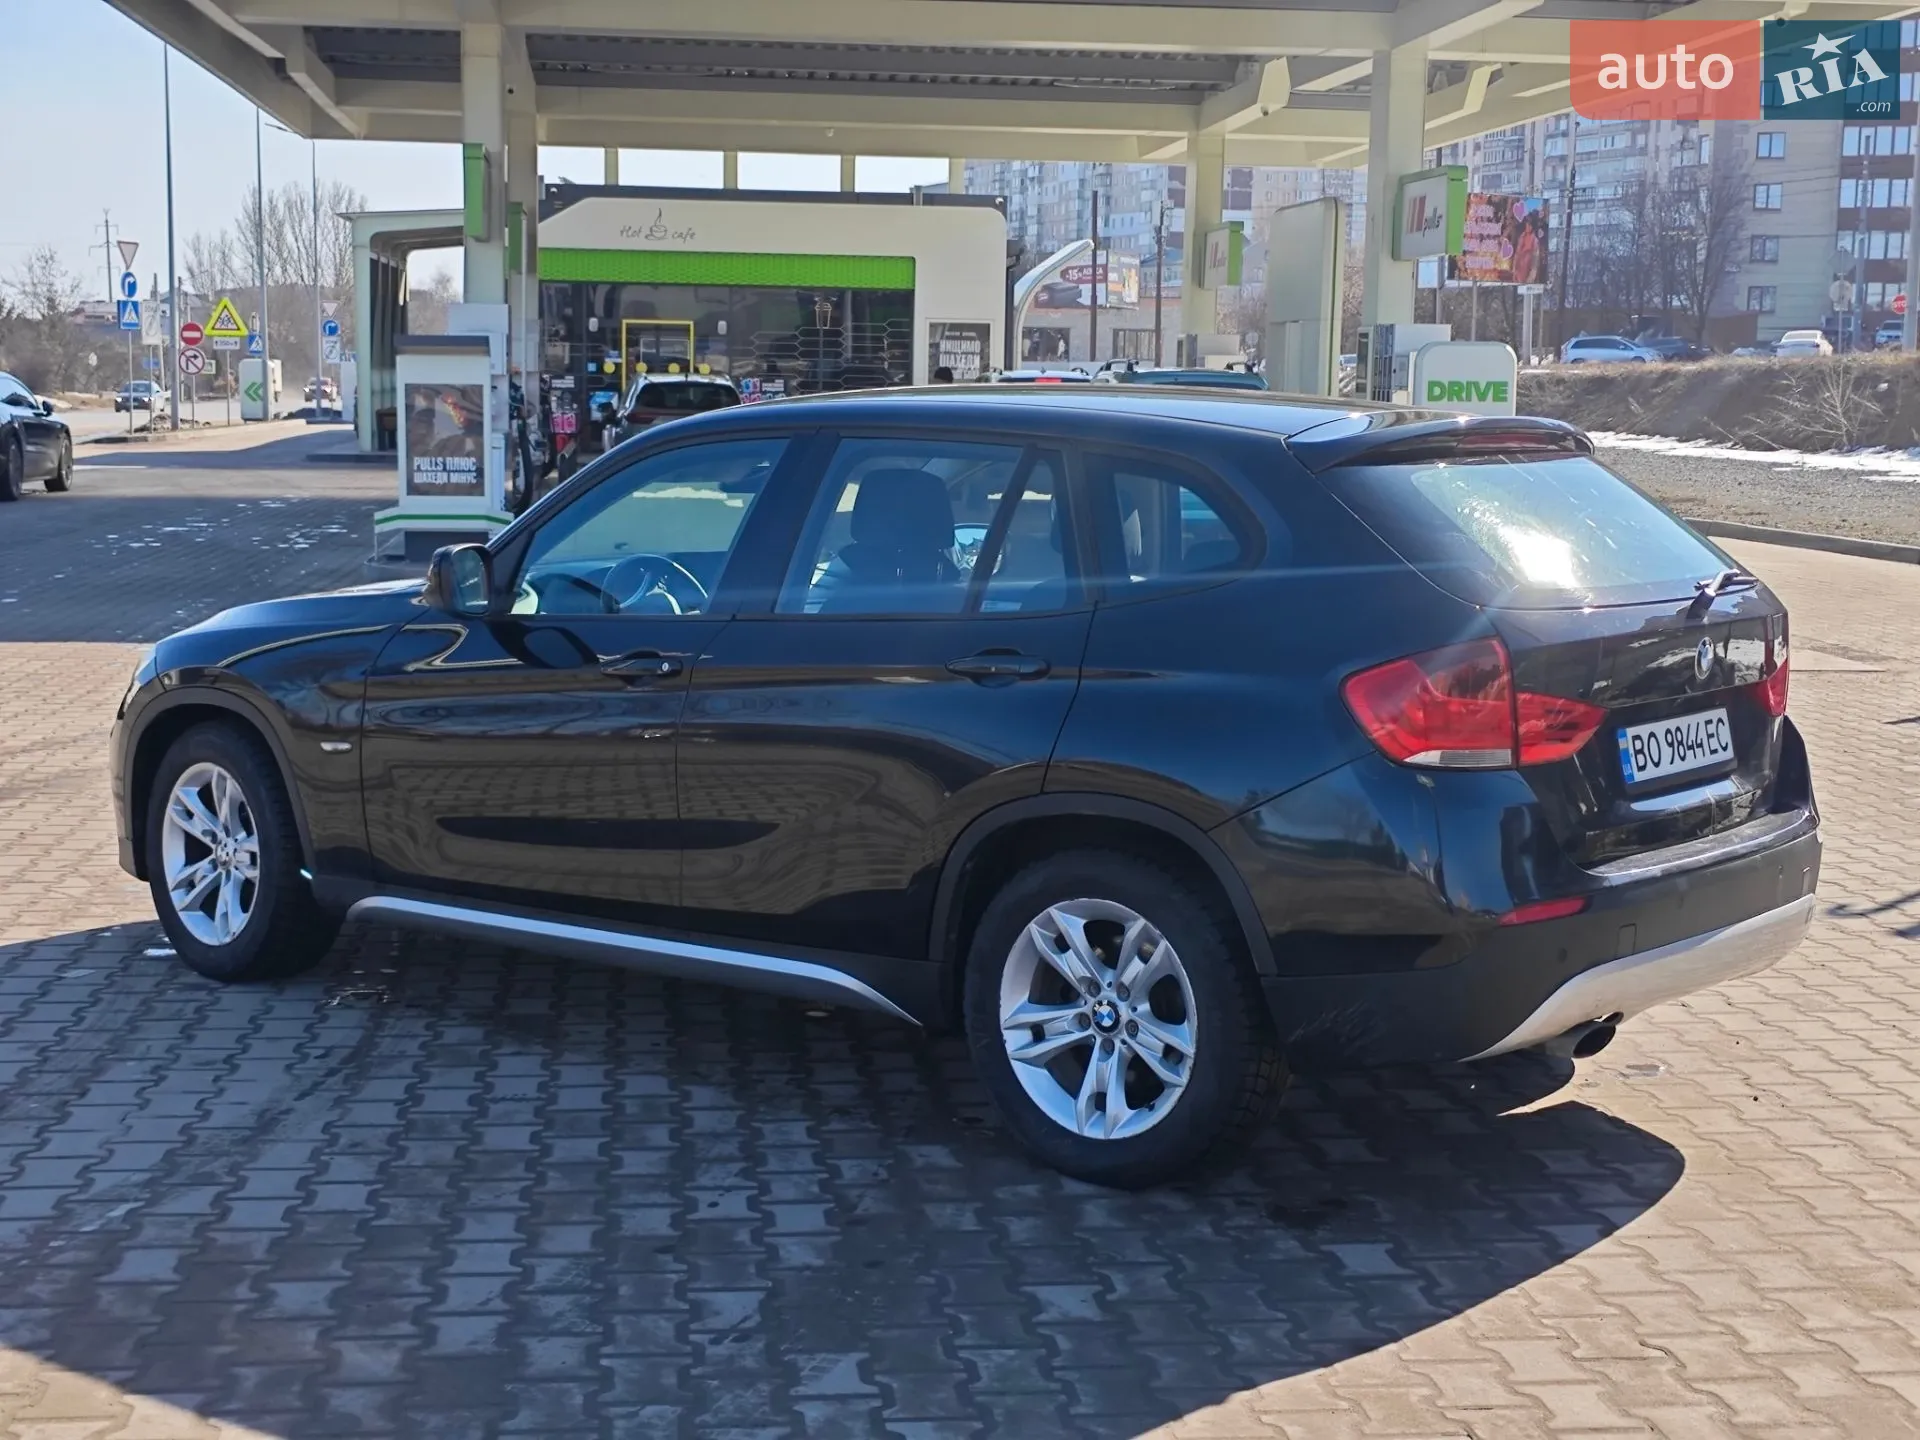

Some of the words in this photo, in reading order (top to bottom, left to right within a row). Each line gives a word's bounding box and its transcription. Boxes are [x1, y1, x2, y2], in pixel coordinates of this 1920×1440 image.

[620, 226, 642, 238] Hot
[672, 227, 696, 243] cafe
[1427, 381, 1508, 402] DRIVE
[414, 457, 443, 470] PULLS
[446, 457, 477, 471] ПЛЮС
[1631, 731, 1661, 772] BO
[1664, 721, 1706, 766] 9844
[1704, 717, 1728, 755] EC
